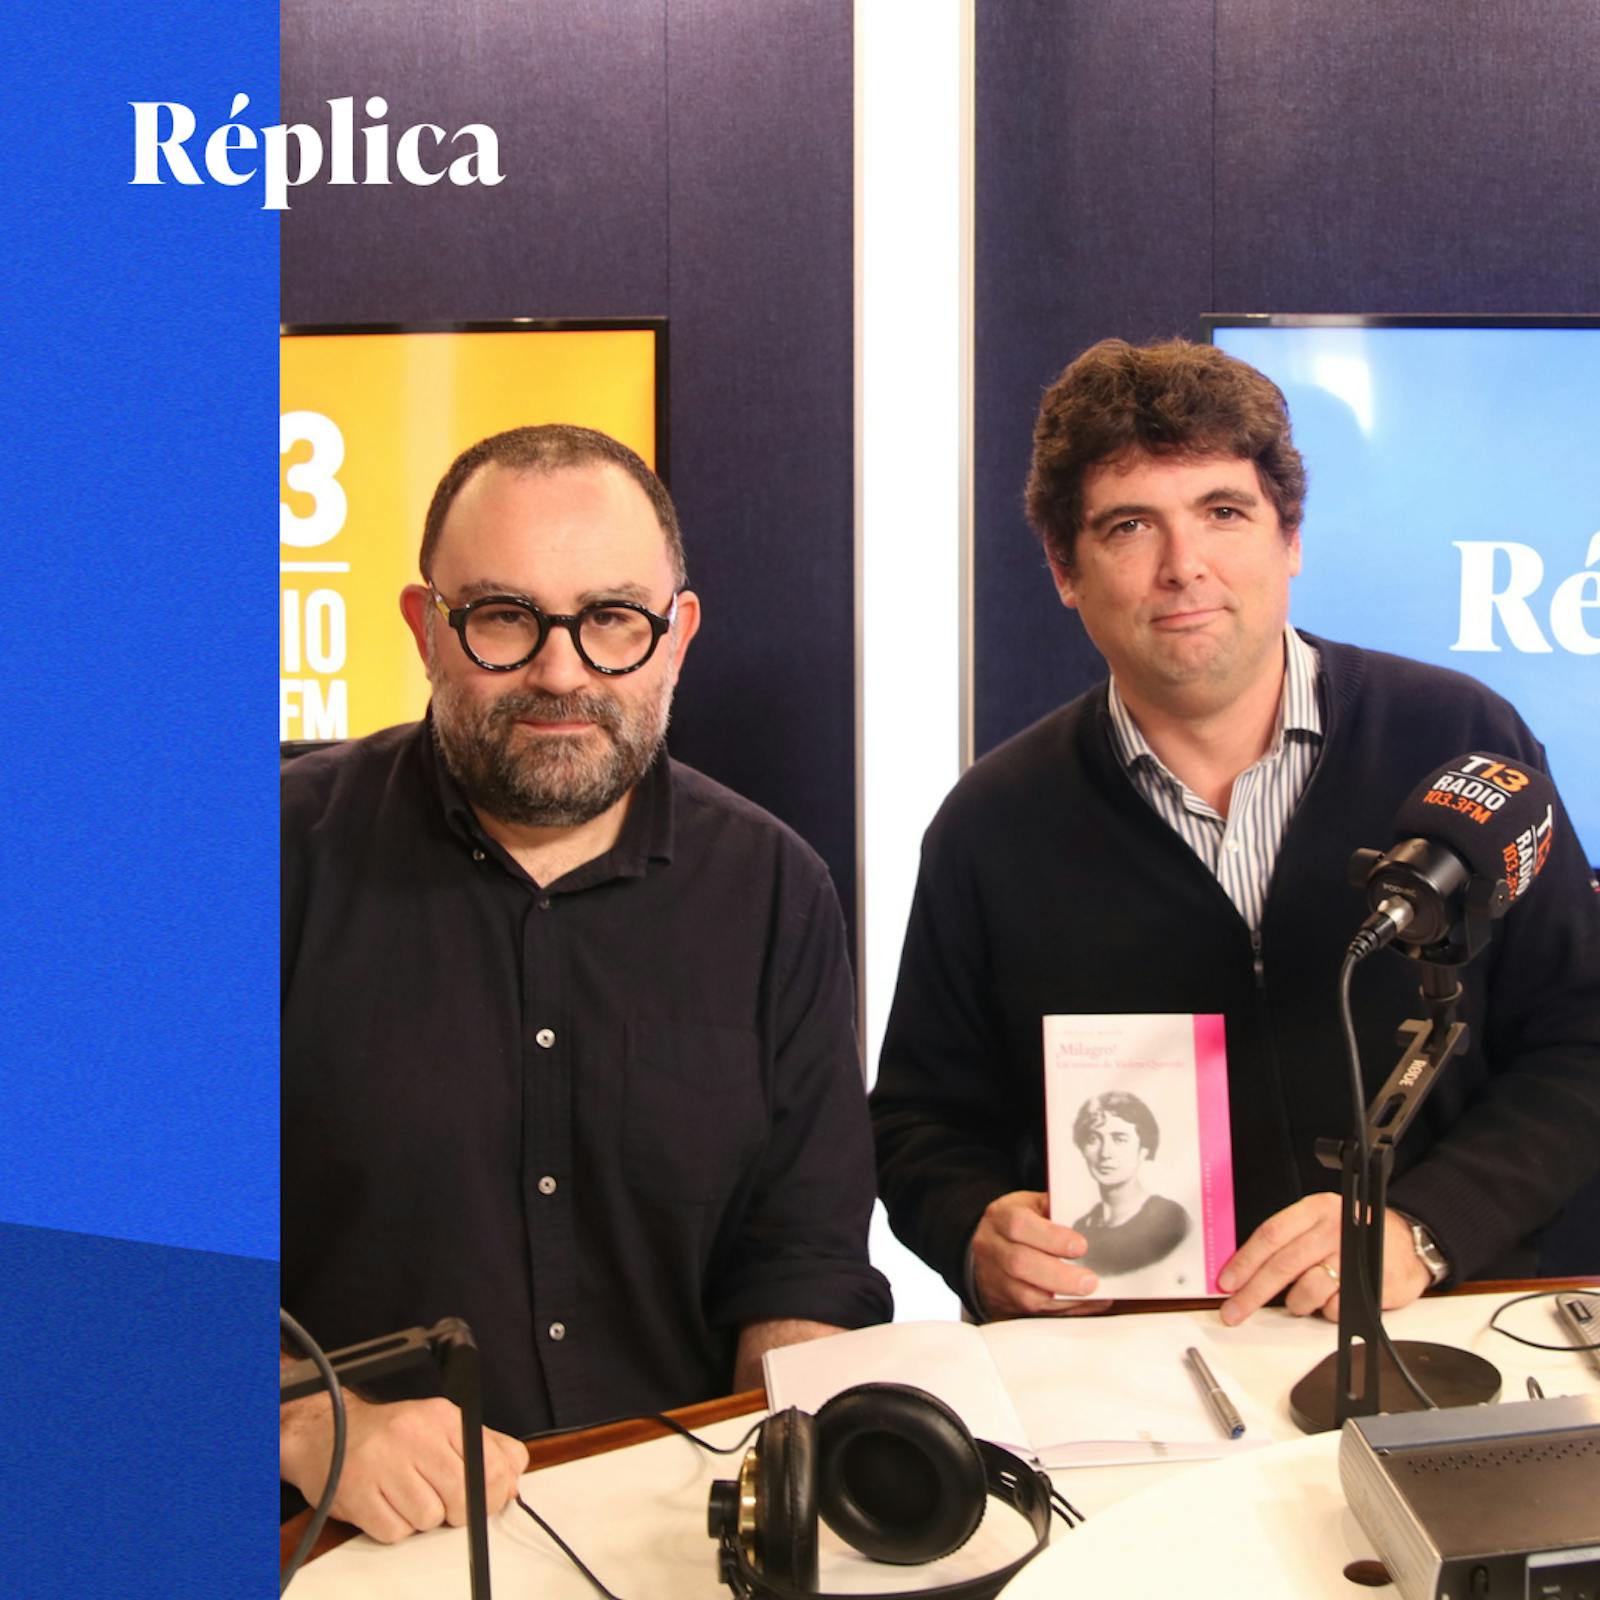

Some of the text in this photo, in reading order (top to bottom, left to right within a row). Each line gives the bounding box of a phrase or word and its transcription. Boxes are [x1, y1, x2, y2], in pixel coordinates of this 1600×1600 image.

[1449, 530, 1600, 656] Ré
[1461, 755, 1529, 792] T13
[1423, 790, 1493, 824] 103.3FM
[1432, 774, 1506, 811] RADIO
[1515, 829, 1533, 896] RADIO
